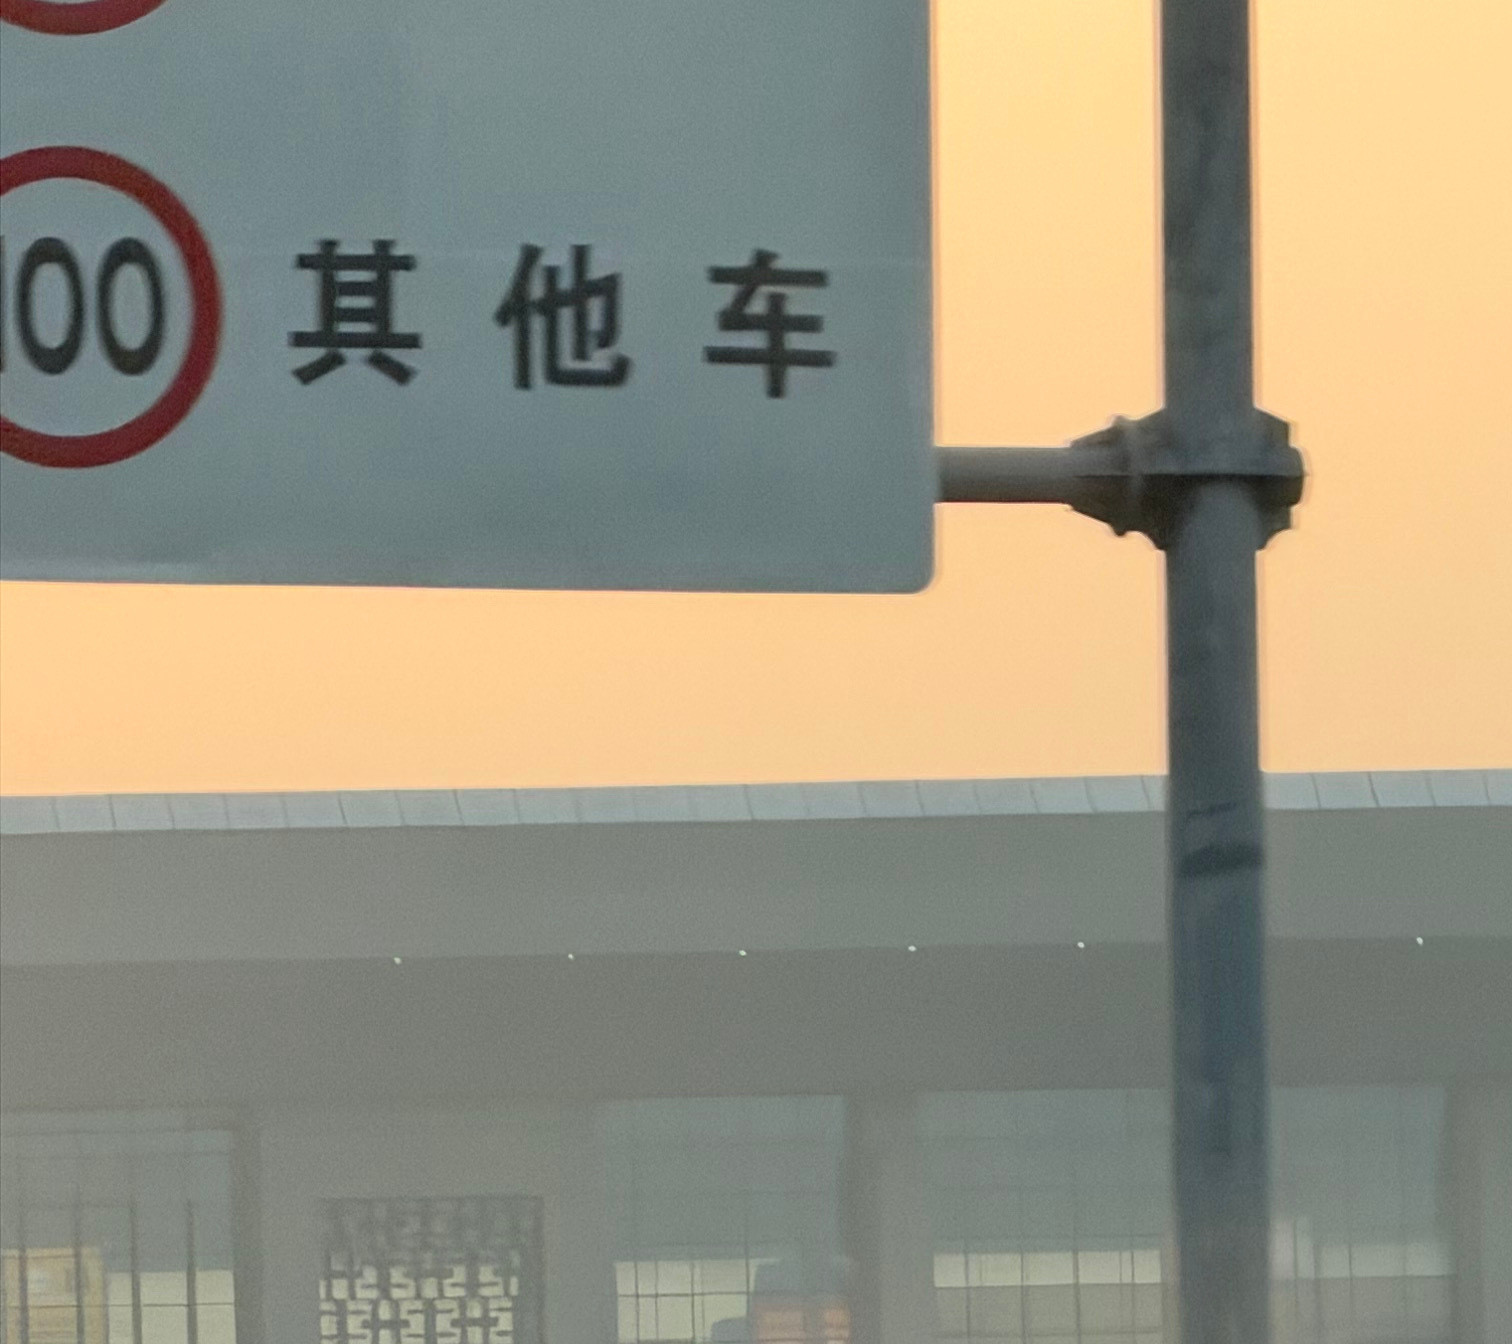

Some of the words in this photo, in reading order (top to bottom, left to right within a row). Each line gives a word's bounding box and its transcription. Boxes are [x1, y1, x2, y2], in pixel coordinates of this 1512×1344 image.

[0, 235, 165, 376] 00
[288, 238, 838, 400] 其他车
